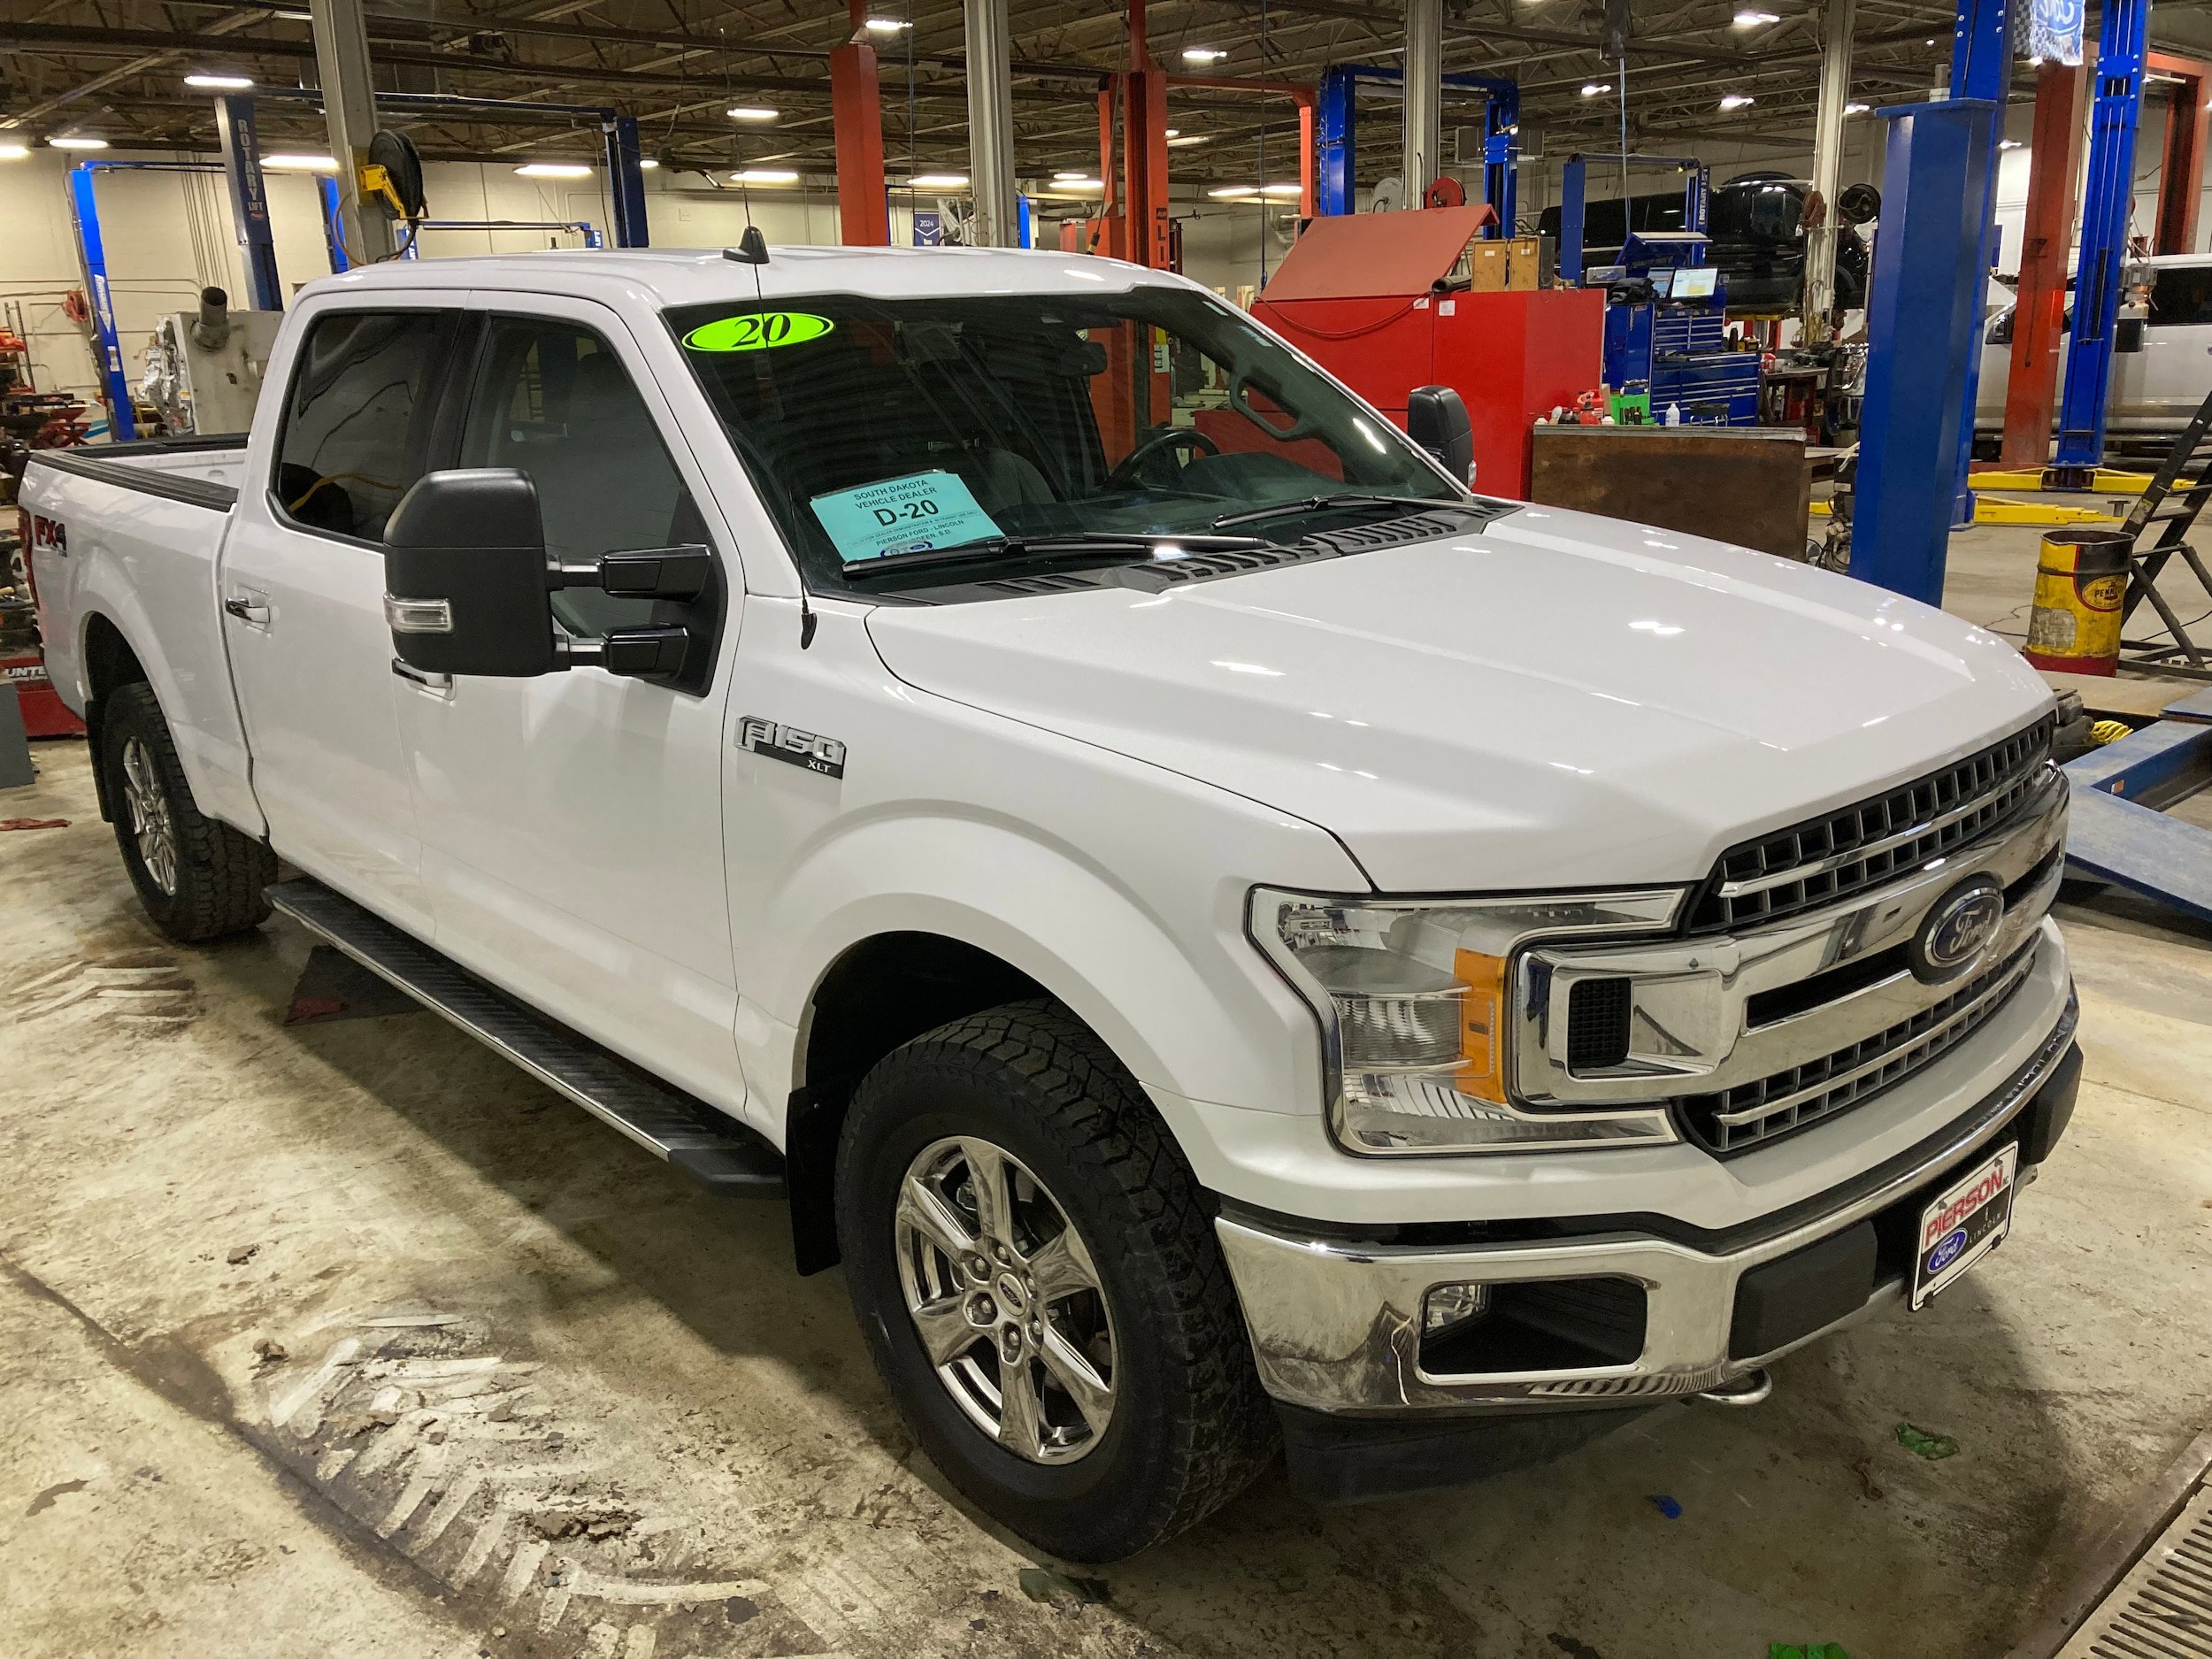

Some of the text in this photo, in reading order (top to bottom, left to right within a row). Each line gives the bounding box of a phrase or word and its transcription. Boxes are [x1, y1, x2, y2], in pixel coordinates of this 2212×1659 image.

[236, 118, 258, 201] ROTARY
[248, 201, 263, 211] LIFT
[731, 313, 791, 348] 20
[854, 480, 929, 501] SOUTH DAKOTA
[855, 487, 938, 510] VEHICLE DEALER
[872, 499, 939, 526] D-20
[35, 514, 67, 551] FX4
[875, 533, 909, 547] PIERSON
[909, 526, 929, 537] FORD
[933, 519, 964, 531] LINCOLN
[807, 758, 832, 773] XLT
[1949, 905, 1993, 955] Ford
[1924, 1166, 2004, 1248] PIERSON
[1934, 1211, 2001, 1268] Ford LINCOLN
